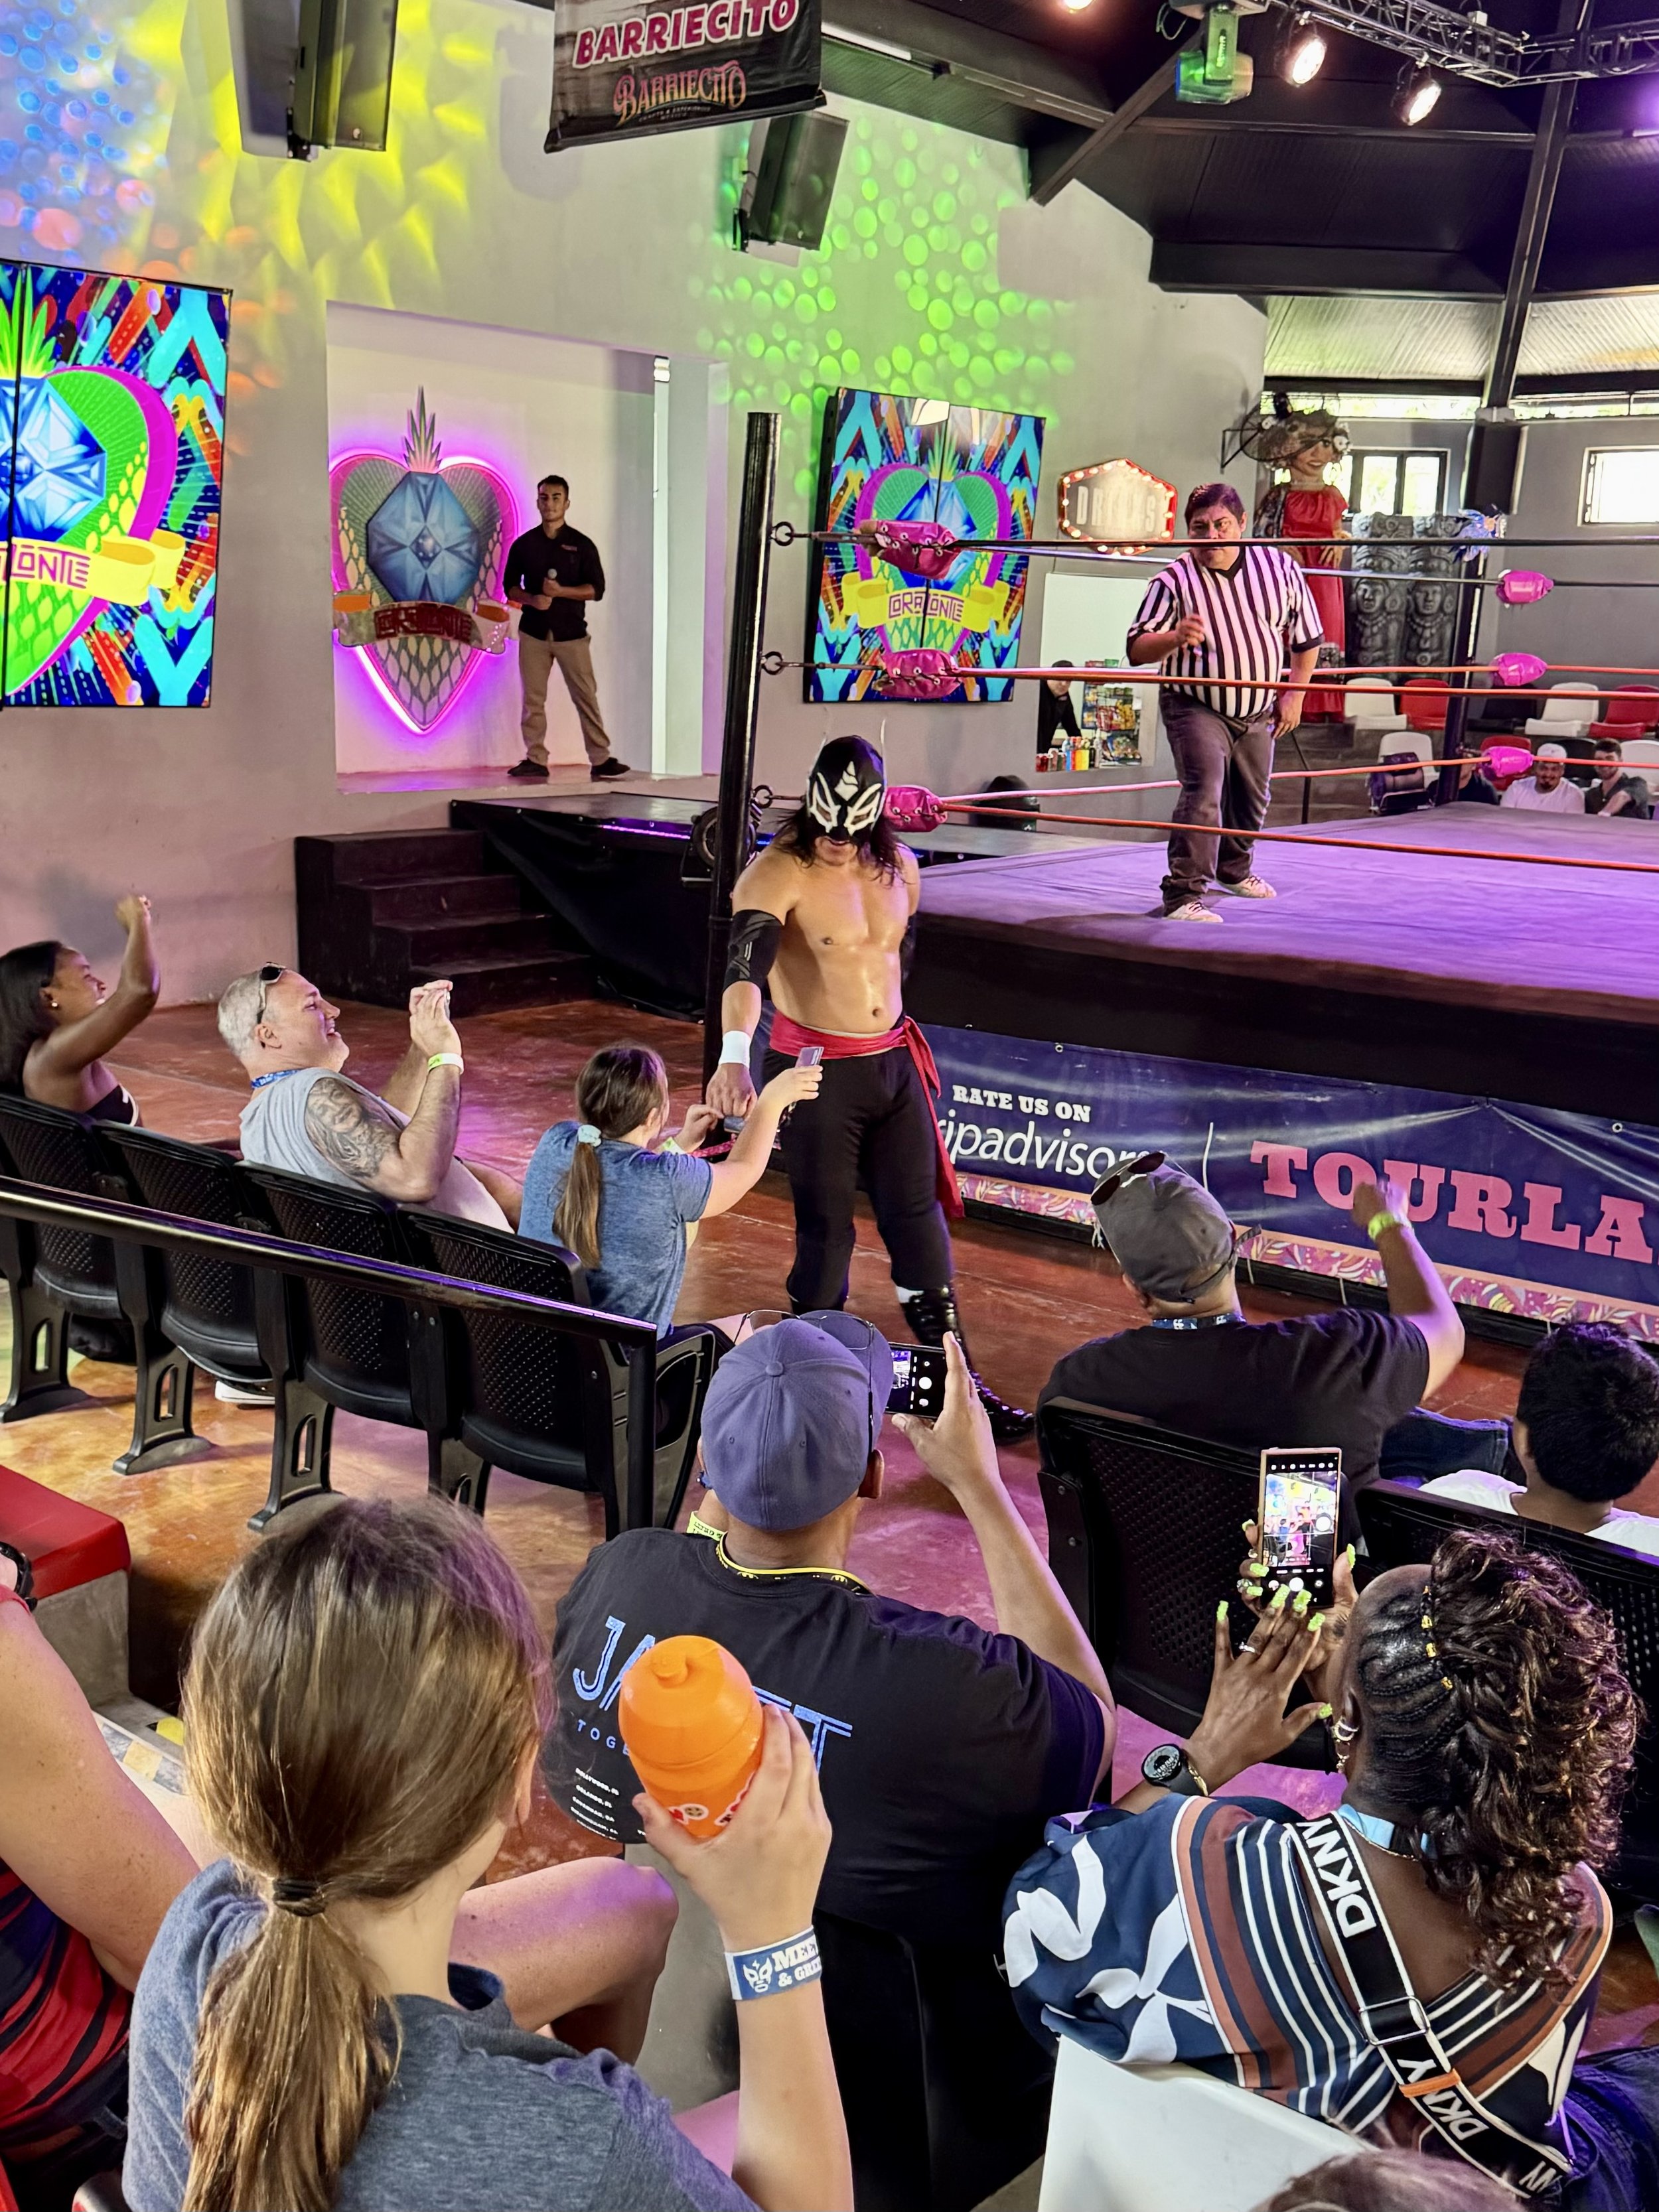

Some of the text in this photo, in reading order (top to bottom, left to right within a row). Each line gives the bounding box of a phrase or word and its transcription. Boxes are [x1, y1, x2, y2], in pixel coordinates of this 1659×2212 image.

[573, 0, 799, 69] BARRIECITO
[613, 60, 747, 127] BARRIECITO
[952, 1085, 1091, 1123] RATE US ON
[1250, 1141, 1658, 1265] TOURLA
[1296, 1818, 1377, 1938] DKNY
[778, 1957, 822, 1987] & GRE
